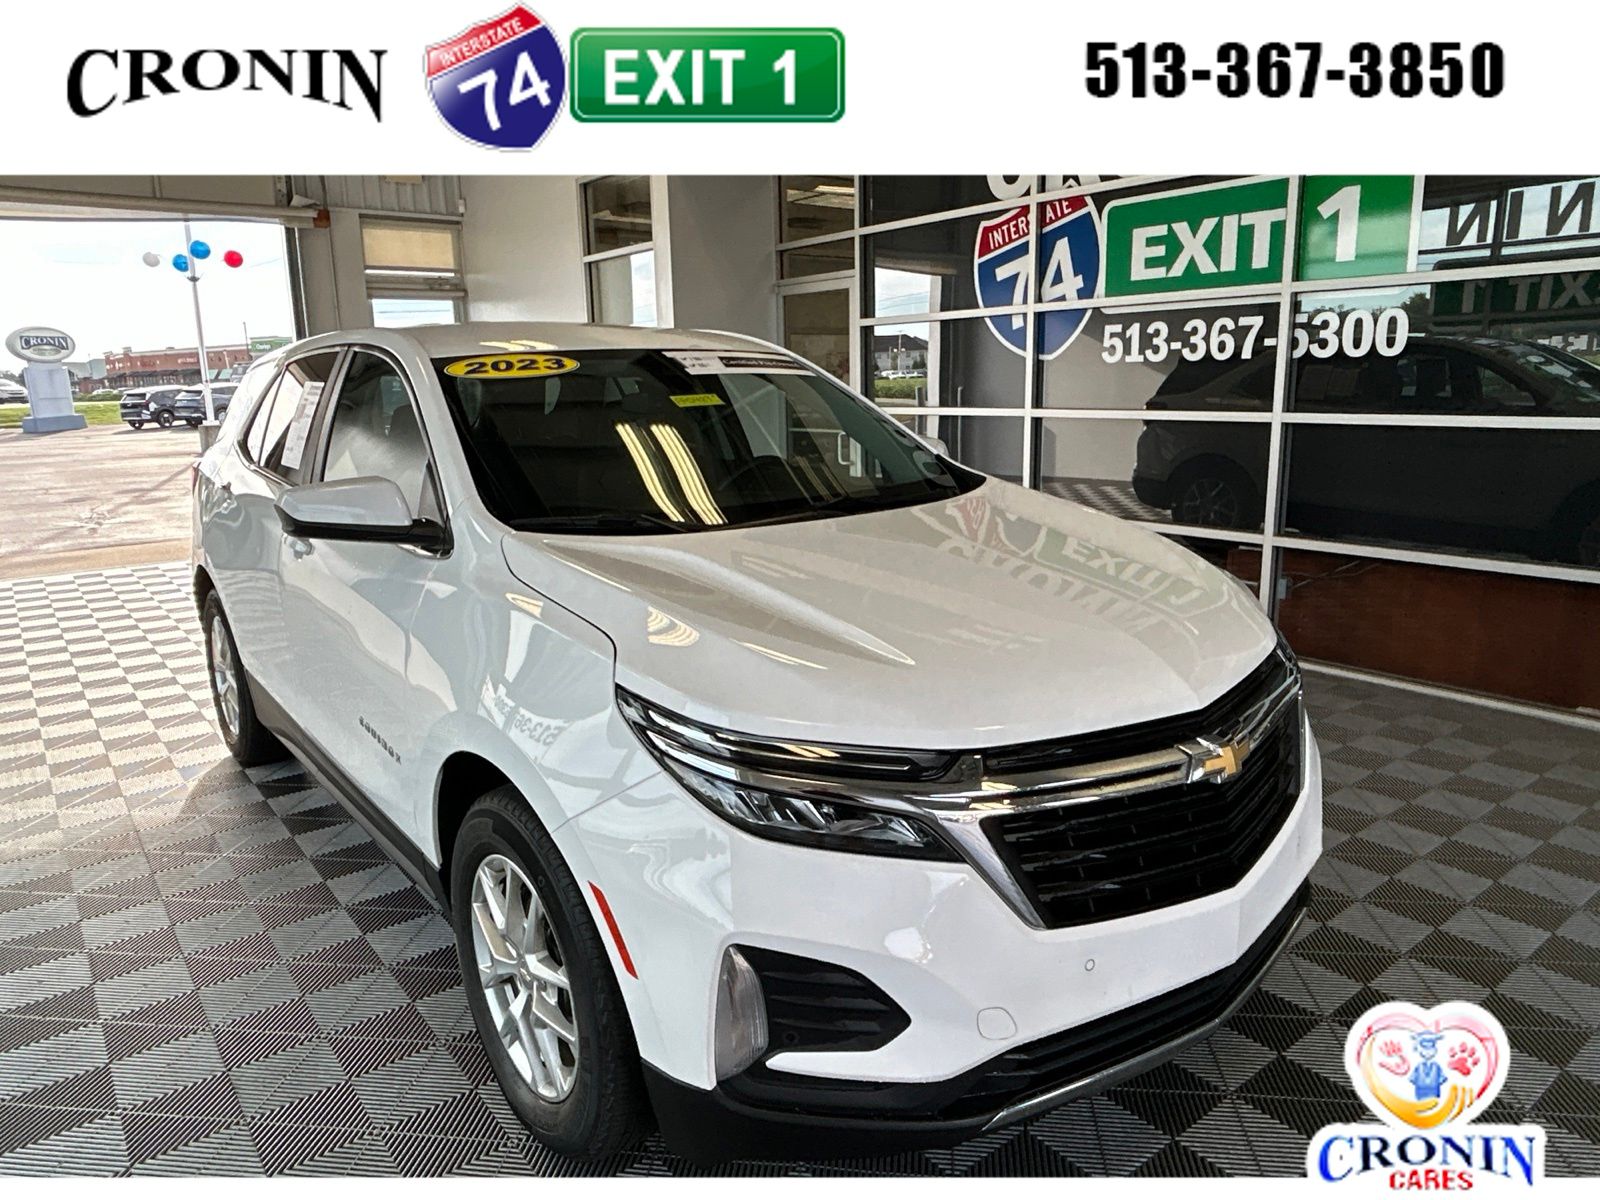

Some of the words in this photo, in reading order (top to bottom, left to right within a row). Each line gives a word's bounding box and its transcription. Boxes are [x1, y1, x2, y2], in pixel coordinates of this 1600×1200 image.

[988, 200, 1073, 251] INTERATE
[1130, 207, 1288, 281] EXIT
[1316, 184, 1361, 263] 1
[995, 236, 1084, 330] 74
[21, 336, 68, 350] CRONIN
[1101, 307, 1409, 365] 513-367-5300
[464, 357, 567, 375] 2023
